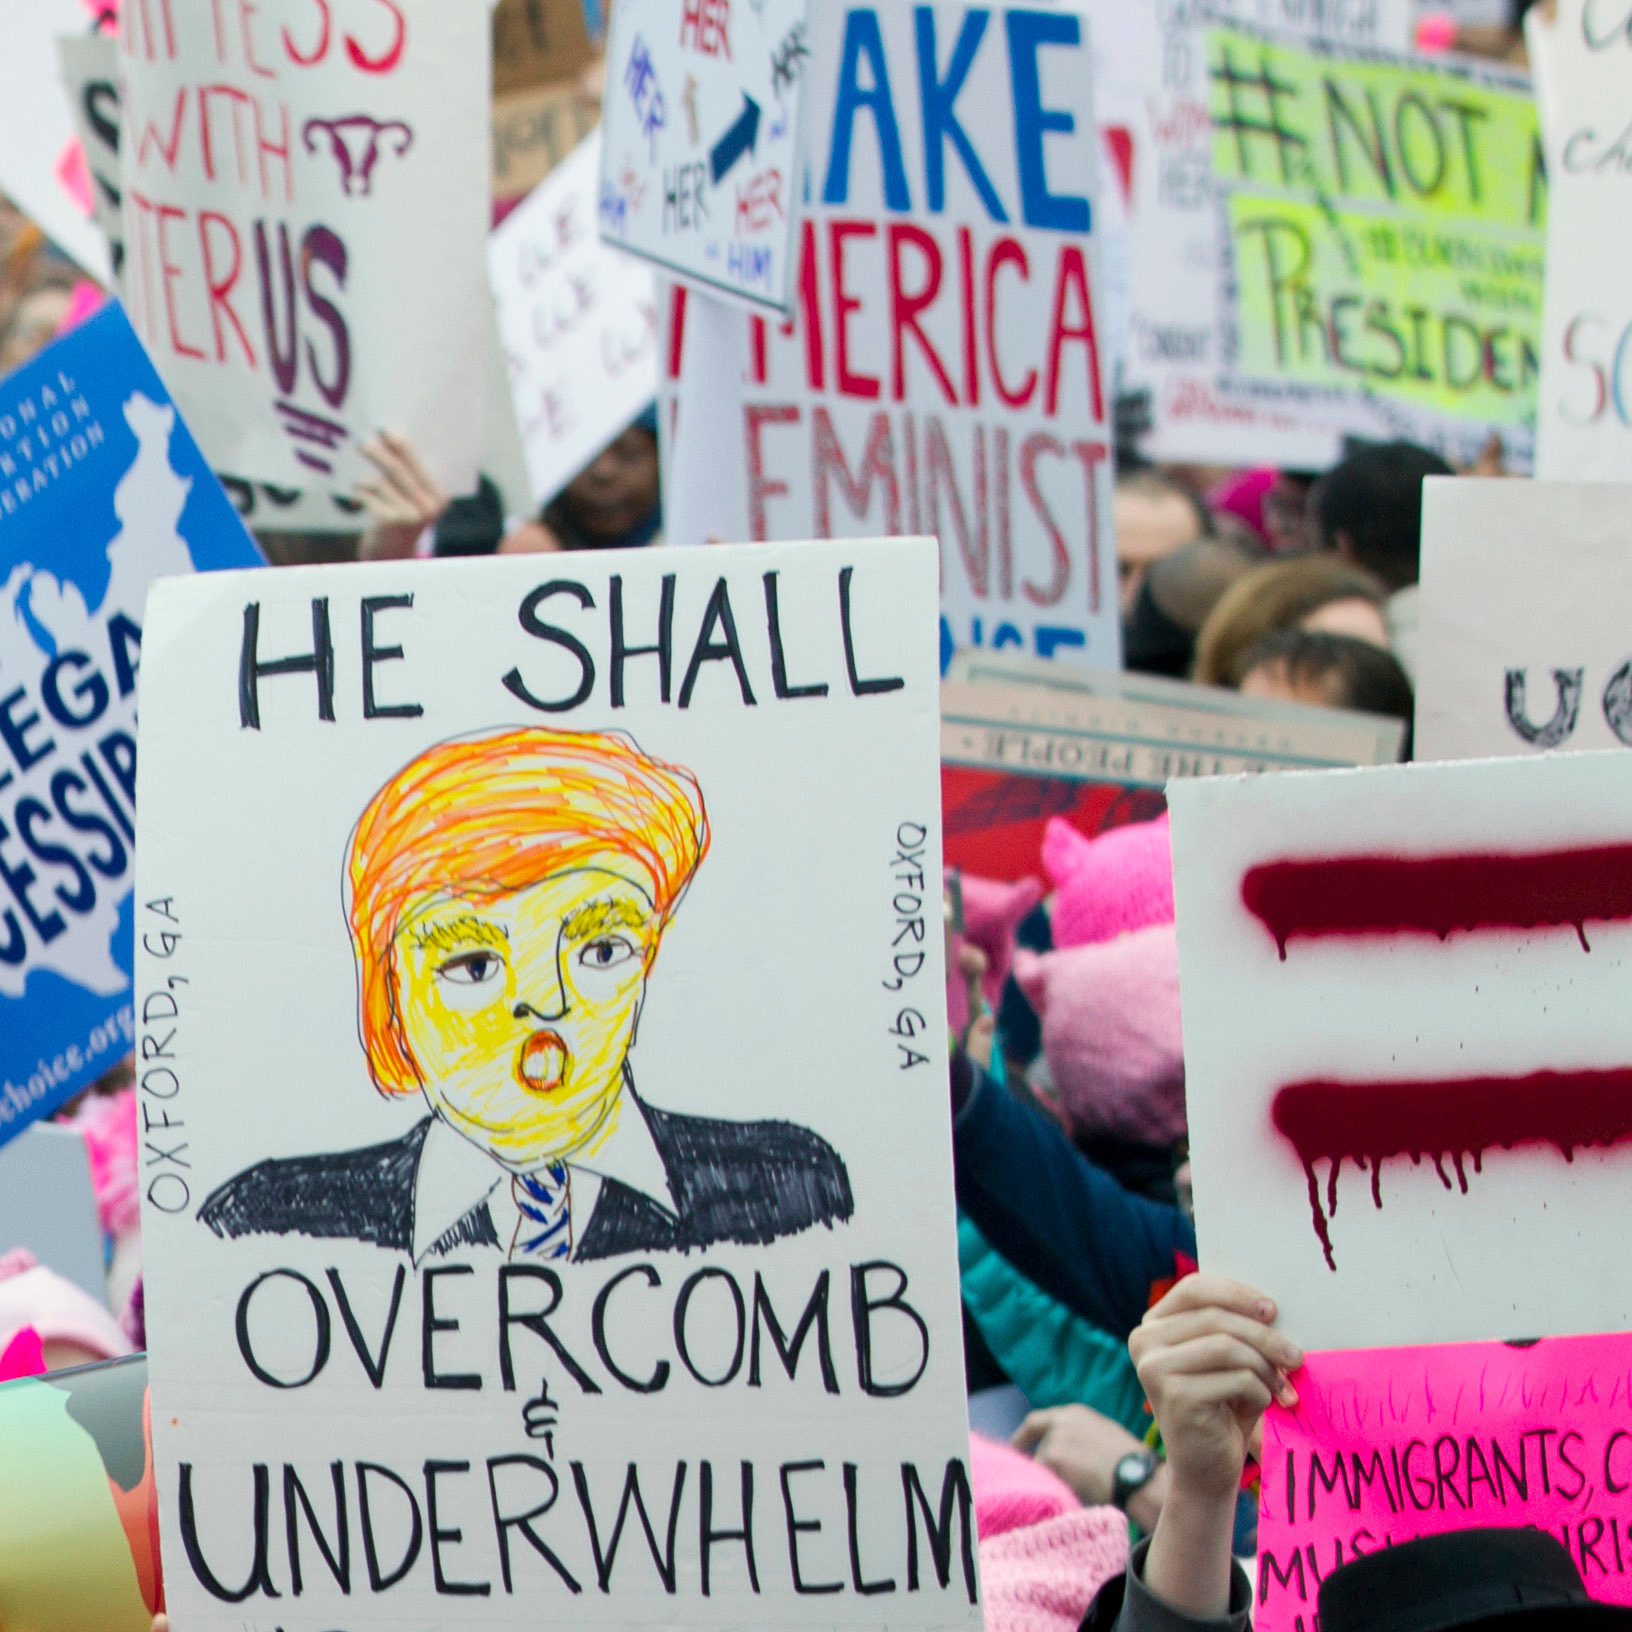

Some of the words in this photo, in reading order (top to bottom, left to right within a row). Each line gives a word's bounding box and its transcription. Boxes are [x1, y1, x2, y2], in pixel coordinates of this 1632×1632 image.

[804, 8, 1091, 234] AKE
[1210, 45, 1488, 208] #NOT
[746, 218, 1105, 424] MERICA
[1236, 208, 1539, 395] PRESIDEN
[240, 592, 425, 731] HE
[501, 566, 905, 712] SHALL
[143, 896, 184, 961] GA
[881, 821, 929, 992] OXFORD,
[141, 975, 191, 1214] OXFORD,
[888, 1006, 930, 1071] GA
[235, 1261, 930, 1397] OVERCOMB
[178, 1454, 979, 1605] UNDERWHELM
[1285, 1428, 1595, 1525] IMMIGRANTS,
